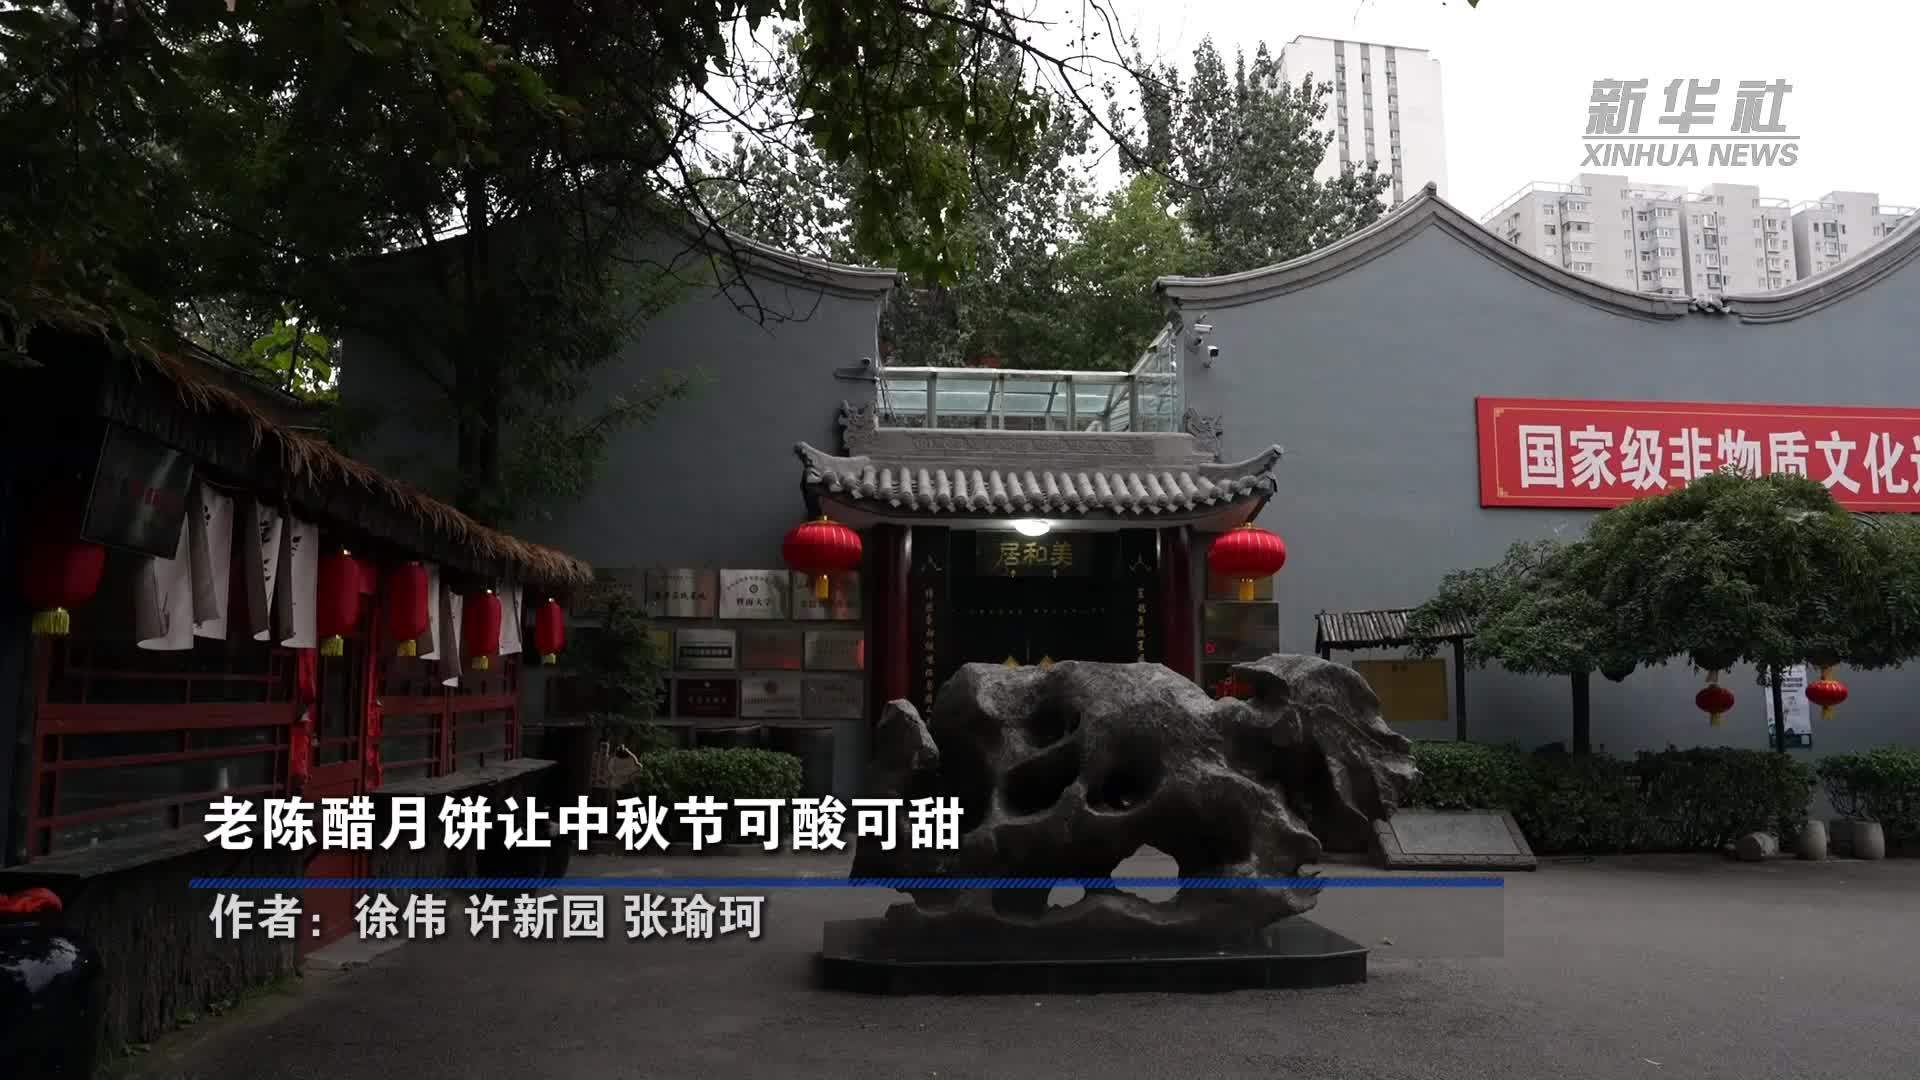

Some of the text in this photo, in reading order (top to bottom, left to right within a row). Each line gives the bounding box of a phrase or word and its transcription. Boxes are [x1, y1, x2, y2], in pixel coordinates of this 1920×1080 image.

[1518, 424, 1920, 495] 国家级非物质文化
